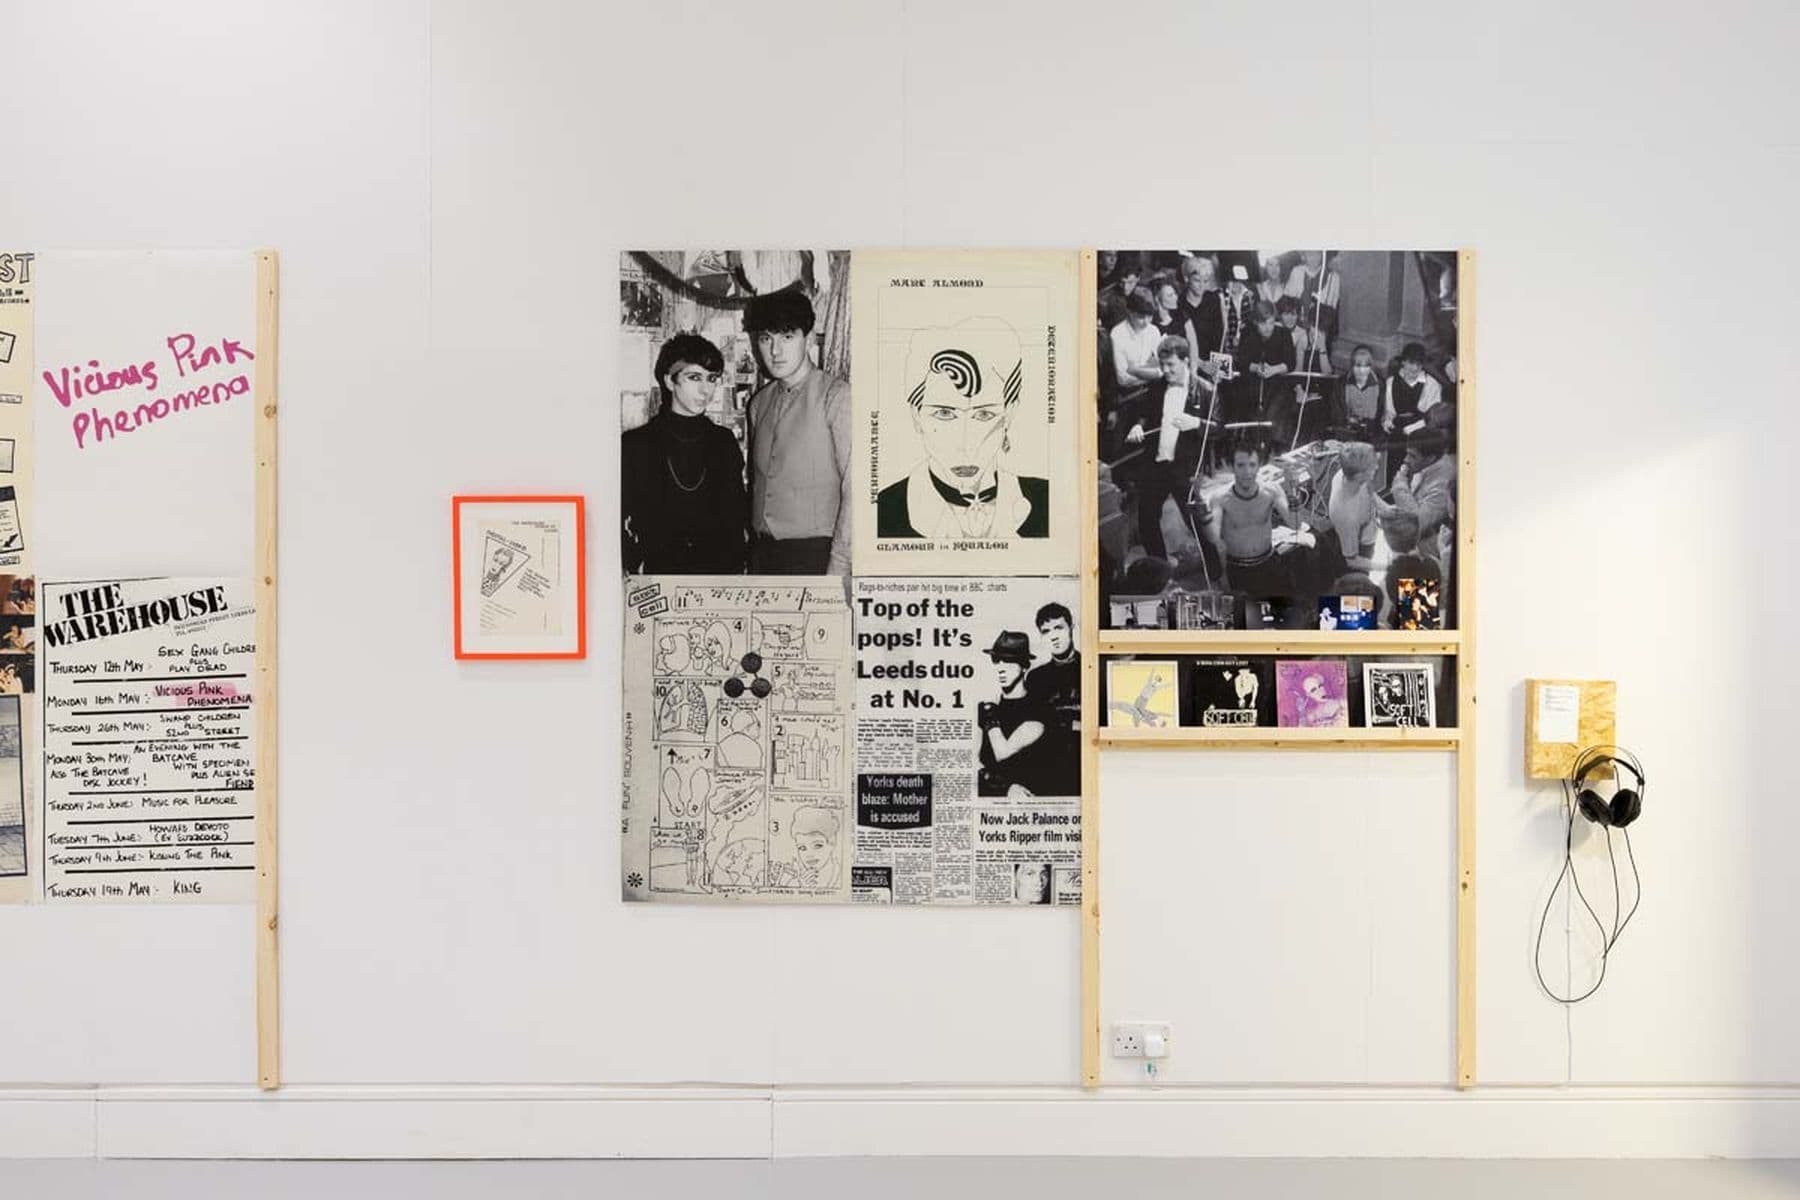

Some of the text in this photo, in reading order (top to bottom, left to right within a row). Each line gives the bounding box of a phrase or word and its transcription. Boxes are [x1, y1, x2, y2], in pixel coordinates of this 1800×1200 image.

[43, 333, 255, 407] Vicious Pink
[877, 543, 935, 551] GLAMOUR
[969, 583, 984, 592] BBC
[59, 583, 124, 618] THE
[857, 598, 901, 620] Top
[906, 598, 930, 617] of
[934, 598, 974, 617] the
[43, 586, 228, 648] WAREHOUSE
[858, 628, 973, 651] pops! It's
[857, 660, 928, 679] Leeds
[930, 660, 974, 679] duo
[870, 689, 964, 709] at No. 1
[775, 725, 783, 736] 2
[867, 775, 924, 788] Yorks death
[861, 793, 928, 806] blaze: Mother
[870, 810, 920, 823] is accused
[980, 813, 1003, 825] Now
[1006, 812, 1029, 825] Jack
[1032, 812, 1069, 825] Palance
[978, 830, 1006, 842] Yorks
[1009, 830, 1041, 845] Ripper
[1044, 830, 1062, 842] film
[173, 880, 202, 895] KING
